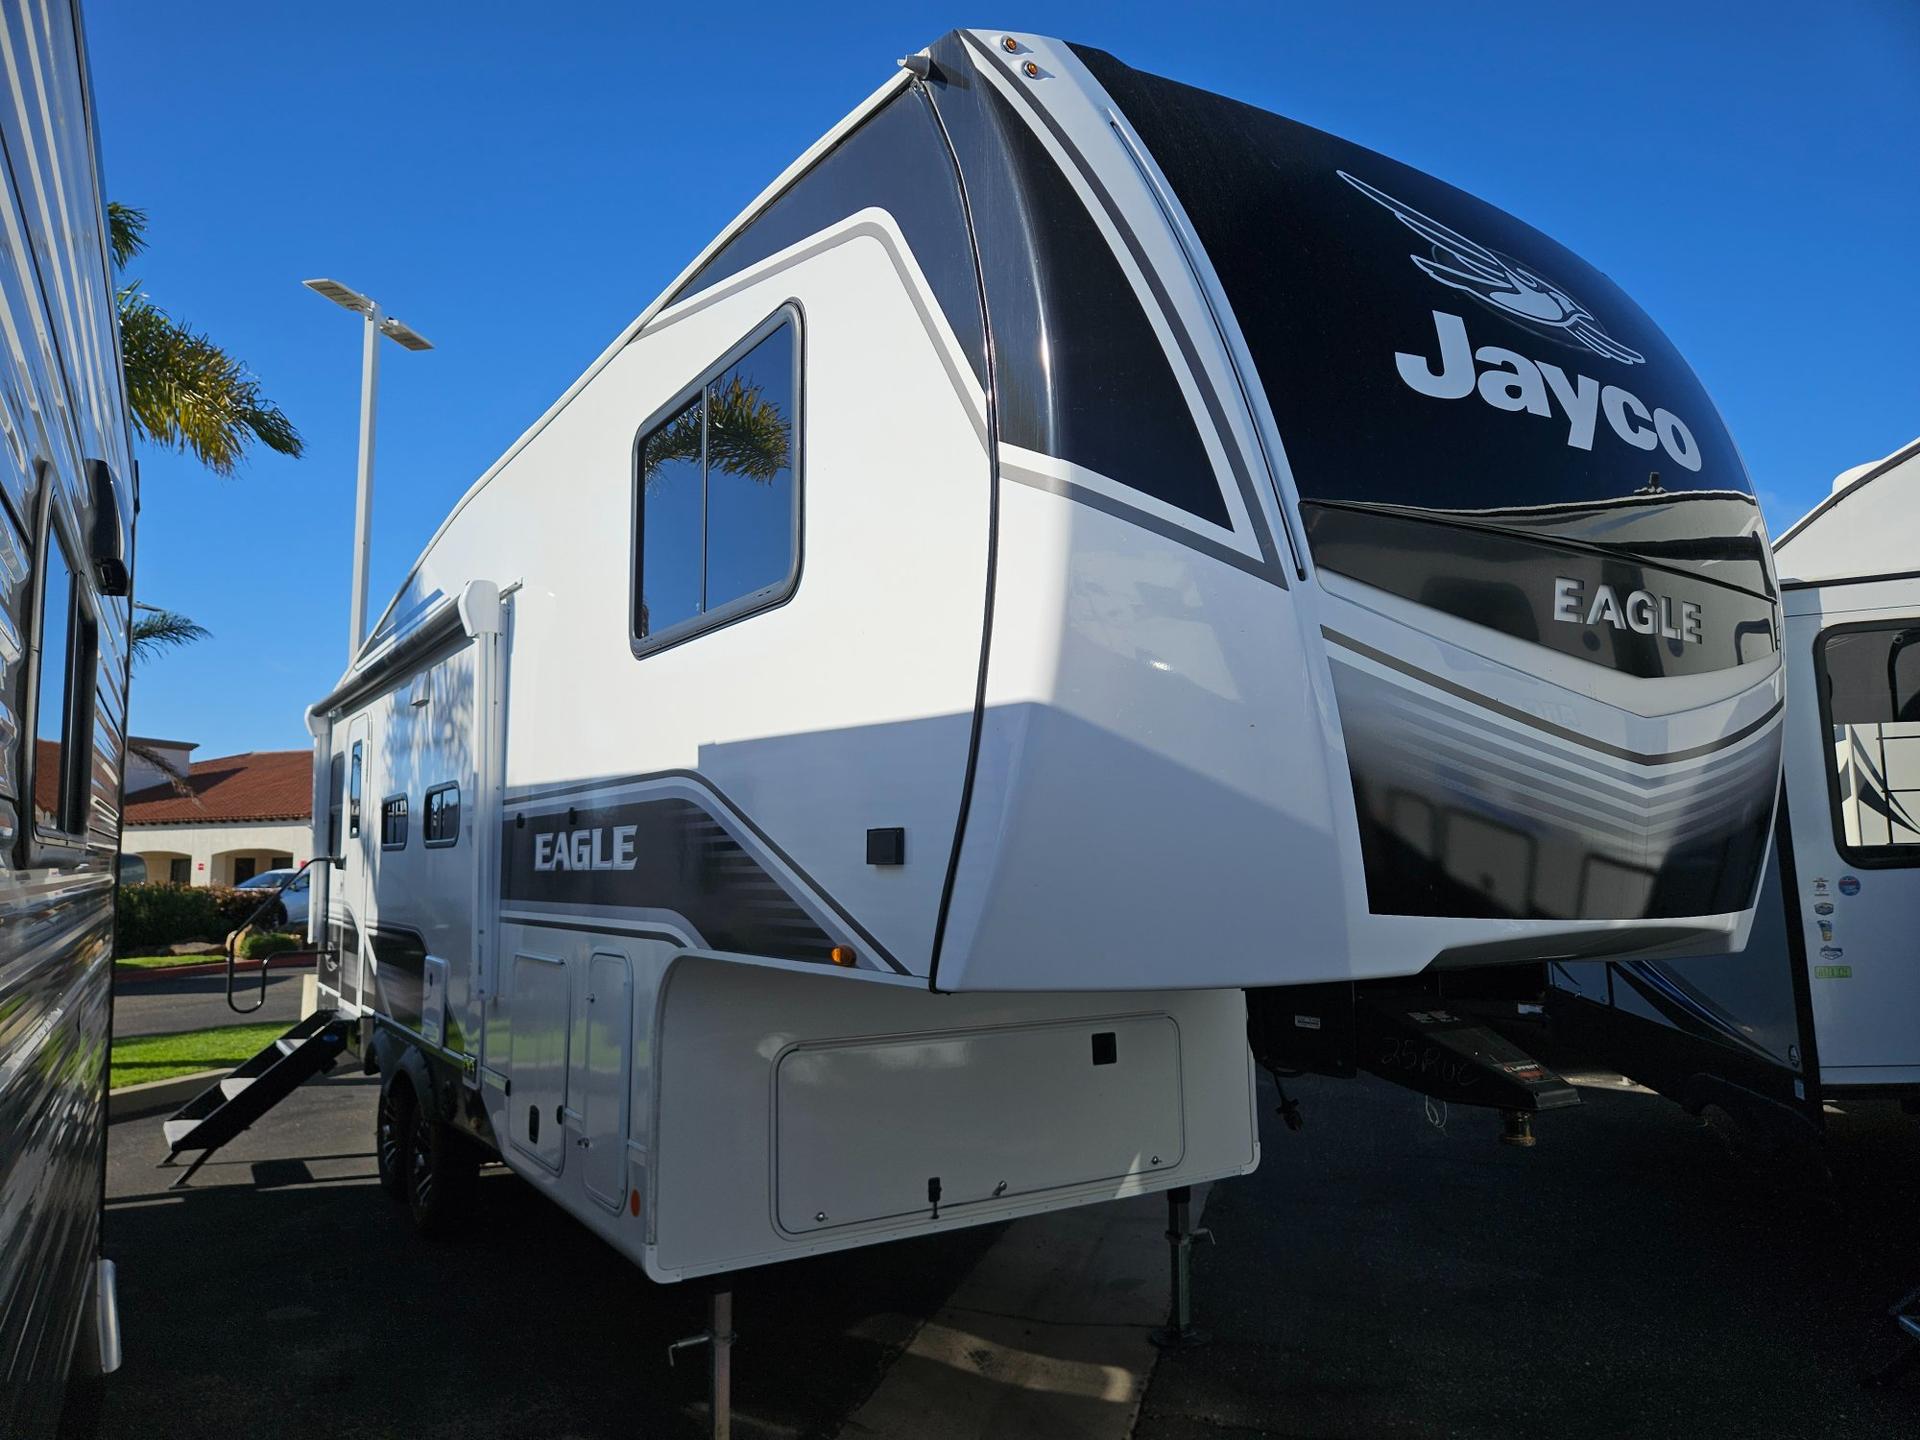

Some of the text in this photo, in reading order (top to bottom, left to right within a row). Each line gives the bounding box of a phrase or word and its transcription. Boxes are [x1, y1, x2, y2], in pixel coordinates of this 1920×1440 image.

[1395, 309, 1702, 472] Jayco
[1553, 576, 1703, 644] EAGLE
[534, 824, 638, 871] EAGLE
